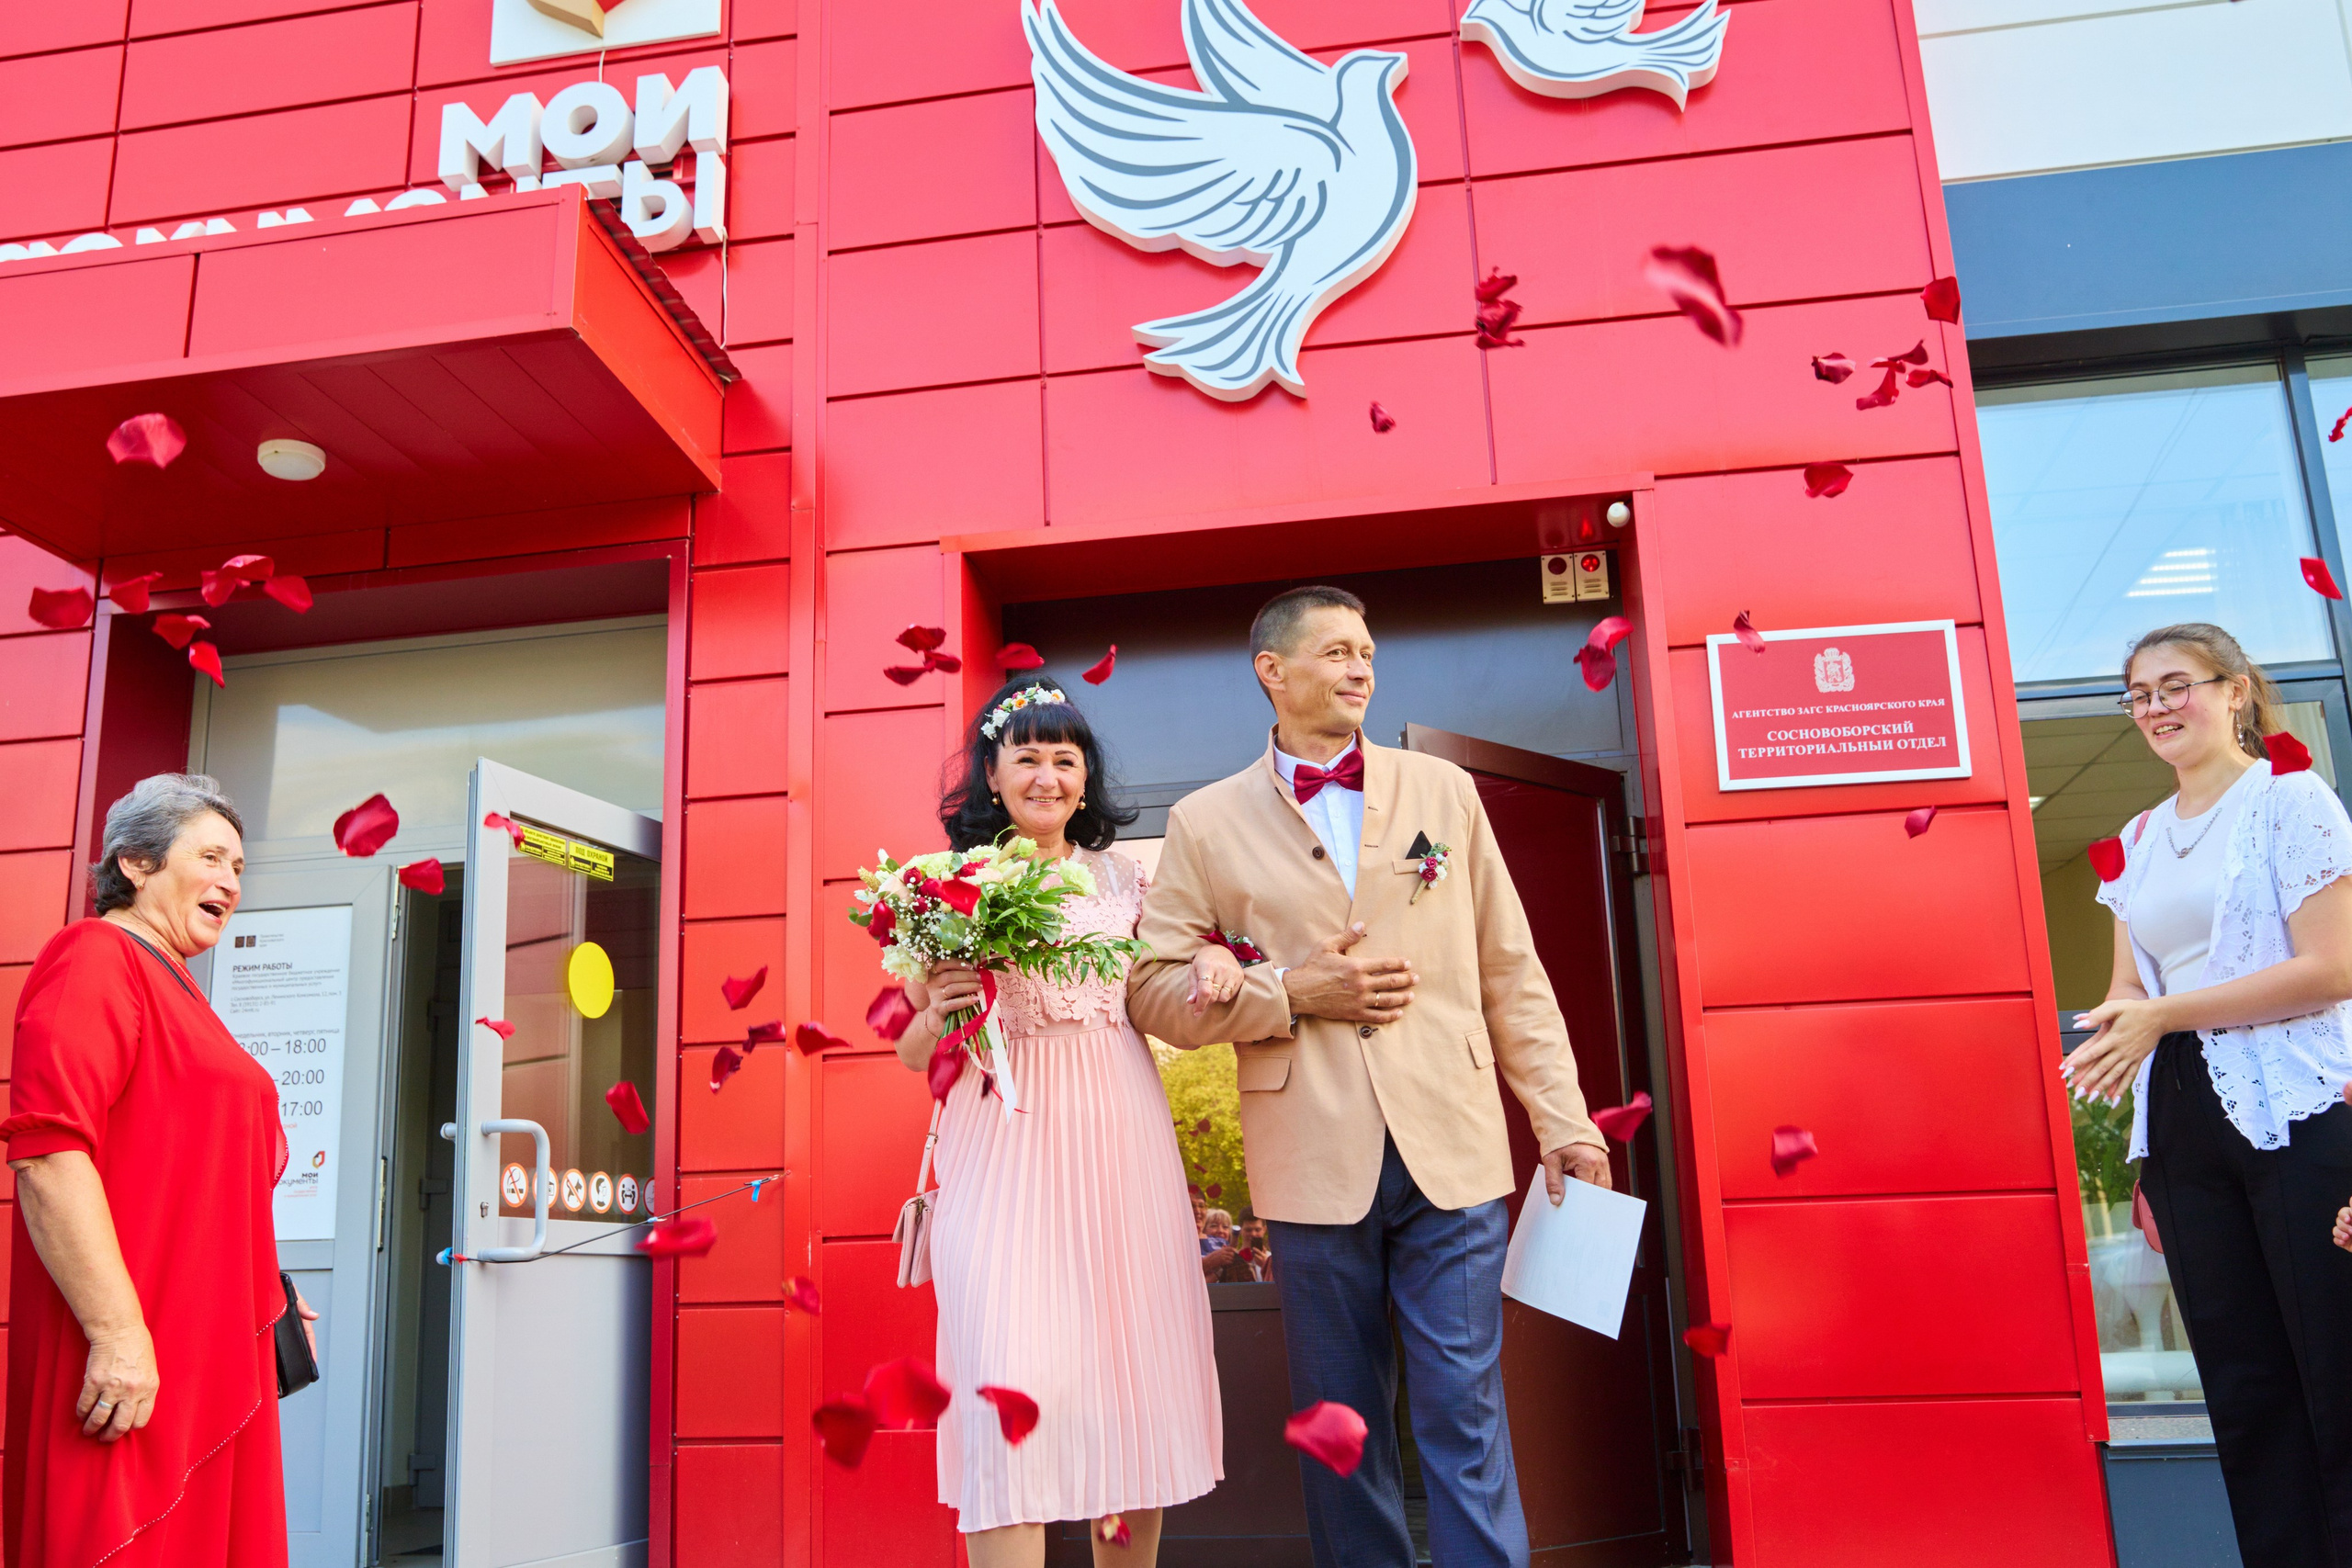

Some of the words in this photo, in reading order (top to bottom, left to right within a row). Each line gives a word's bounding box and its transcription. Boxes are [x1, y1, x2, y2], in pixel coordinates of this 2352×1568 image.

[1732, 707, 1795, 718] АГЕНТСТВО
[1798, 705, 1823, 715] ЗАГС
[1826, 700, 1916, 714] КРАСНОЯРСКОГО
[1918, 698, 1945, 707] КРАЯ
[1768, 721, 1914, 741] СОСНОВОБОРСКИЙ
[1896, 737, 1946, 751] ОТДЕЛ
[285, 1038, 326, 1054] 18:00
[282, 1069, 324, 1086] 20:00
[281, 1100, 322, 1116] 17:00
